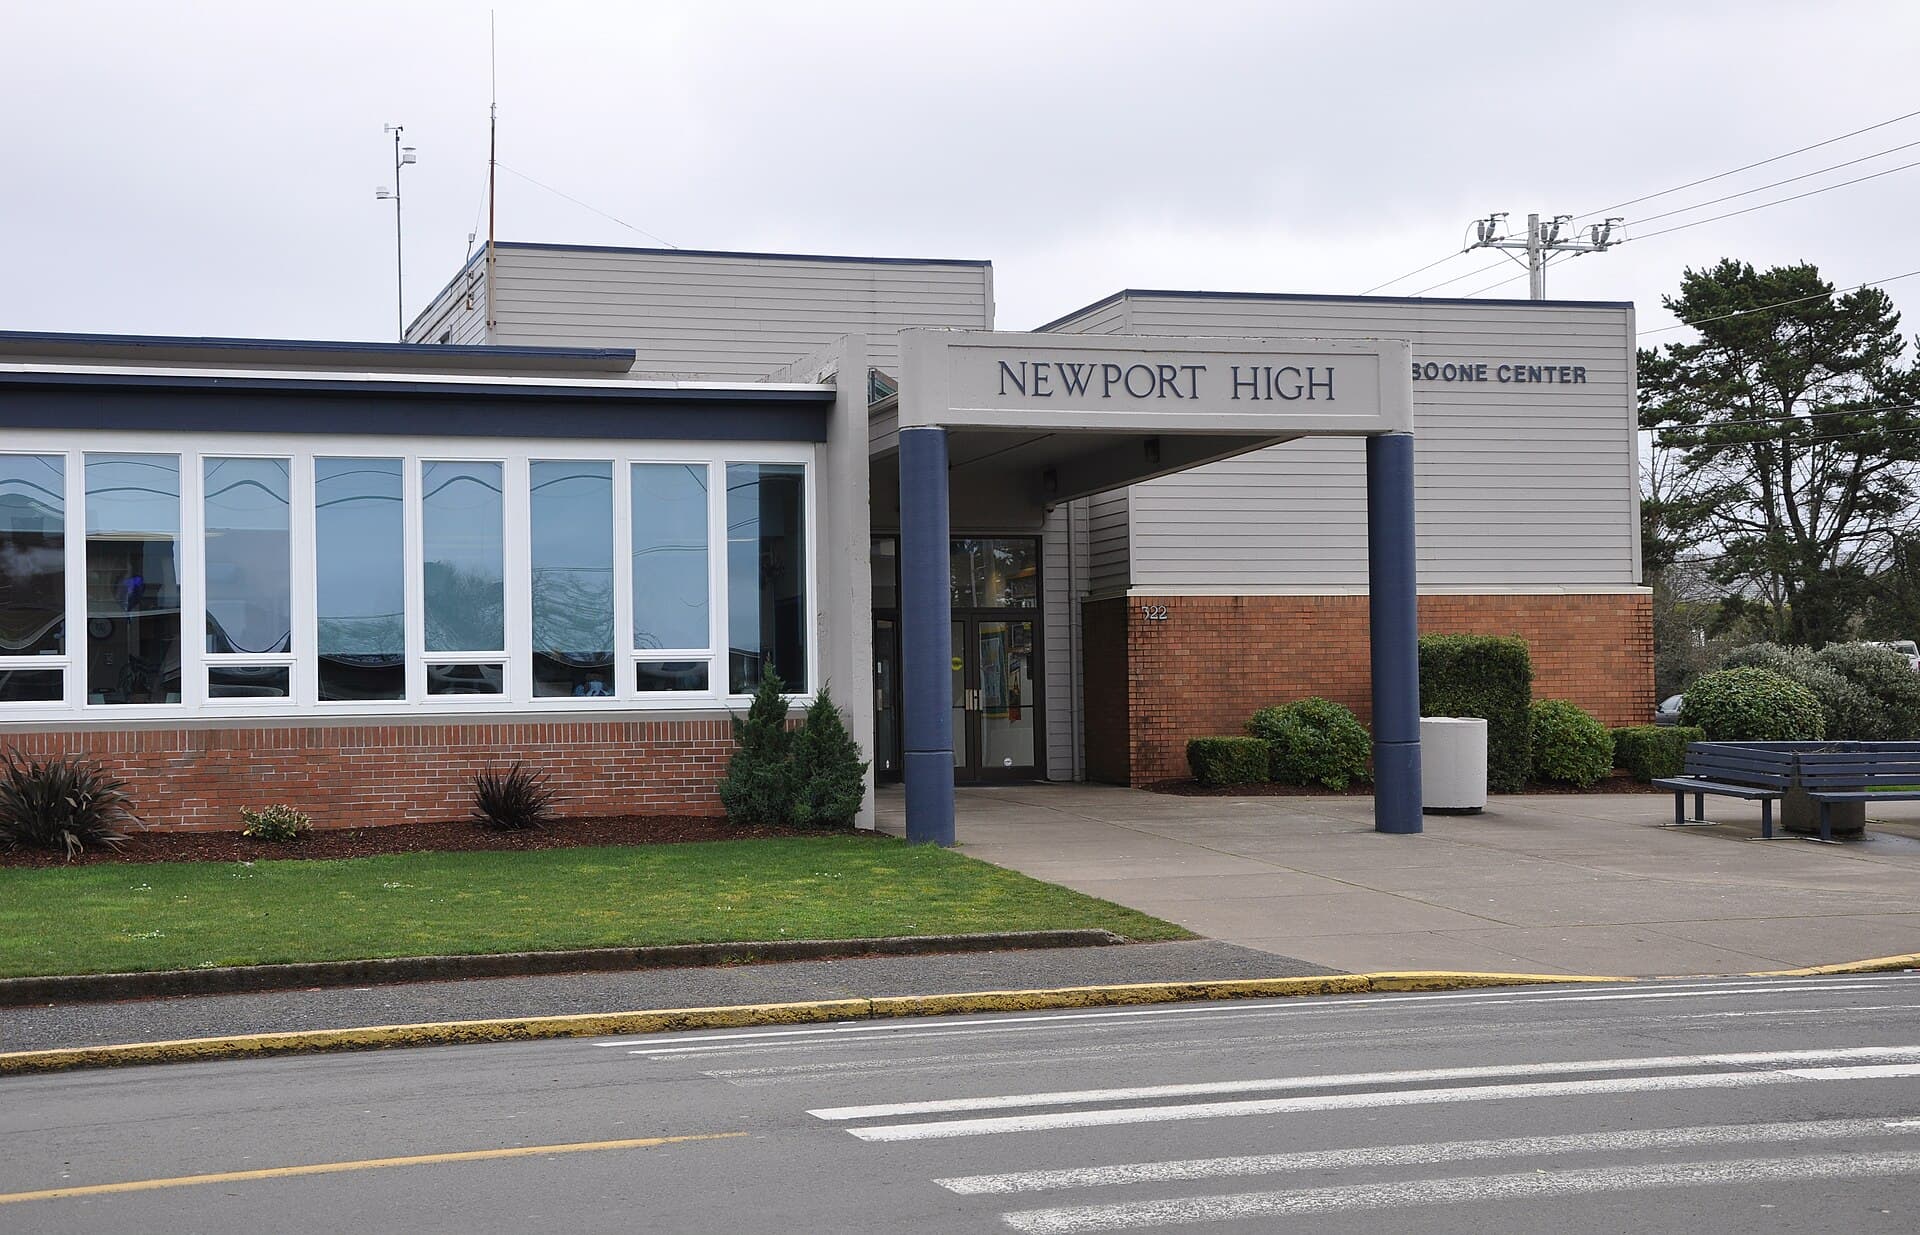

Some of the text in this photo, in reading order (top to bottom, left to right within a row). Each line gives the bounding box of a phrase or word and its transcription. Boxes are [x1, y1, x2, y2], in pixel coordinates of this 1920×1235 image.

[998, 360, 1335, 401] NEWPORT HIGH
[1412, 362, 1587, 384] BOONE CENTER
[1141, 605, 1168, 620] 322
